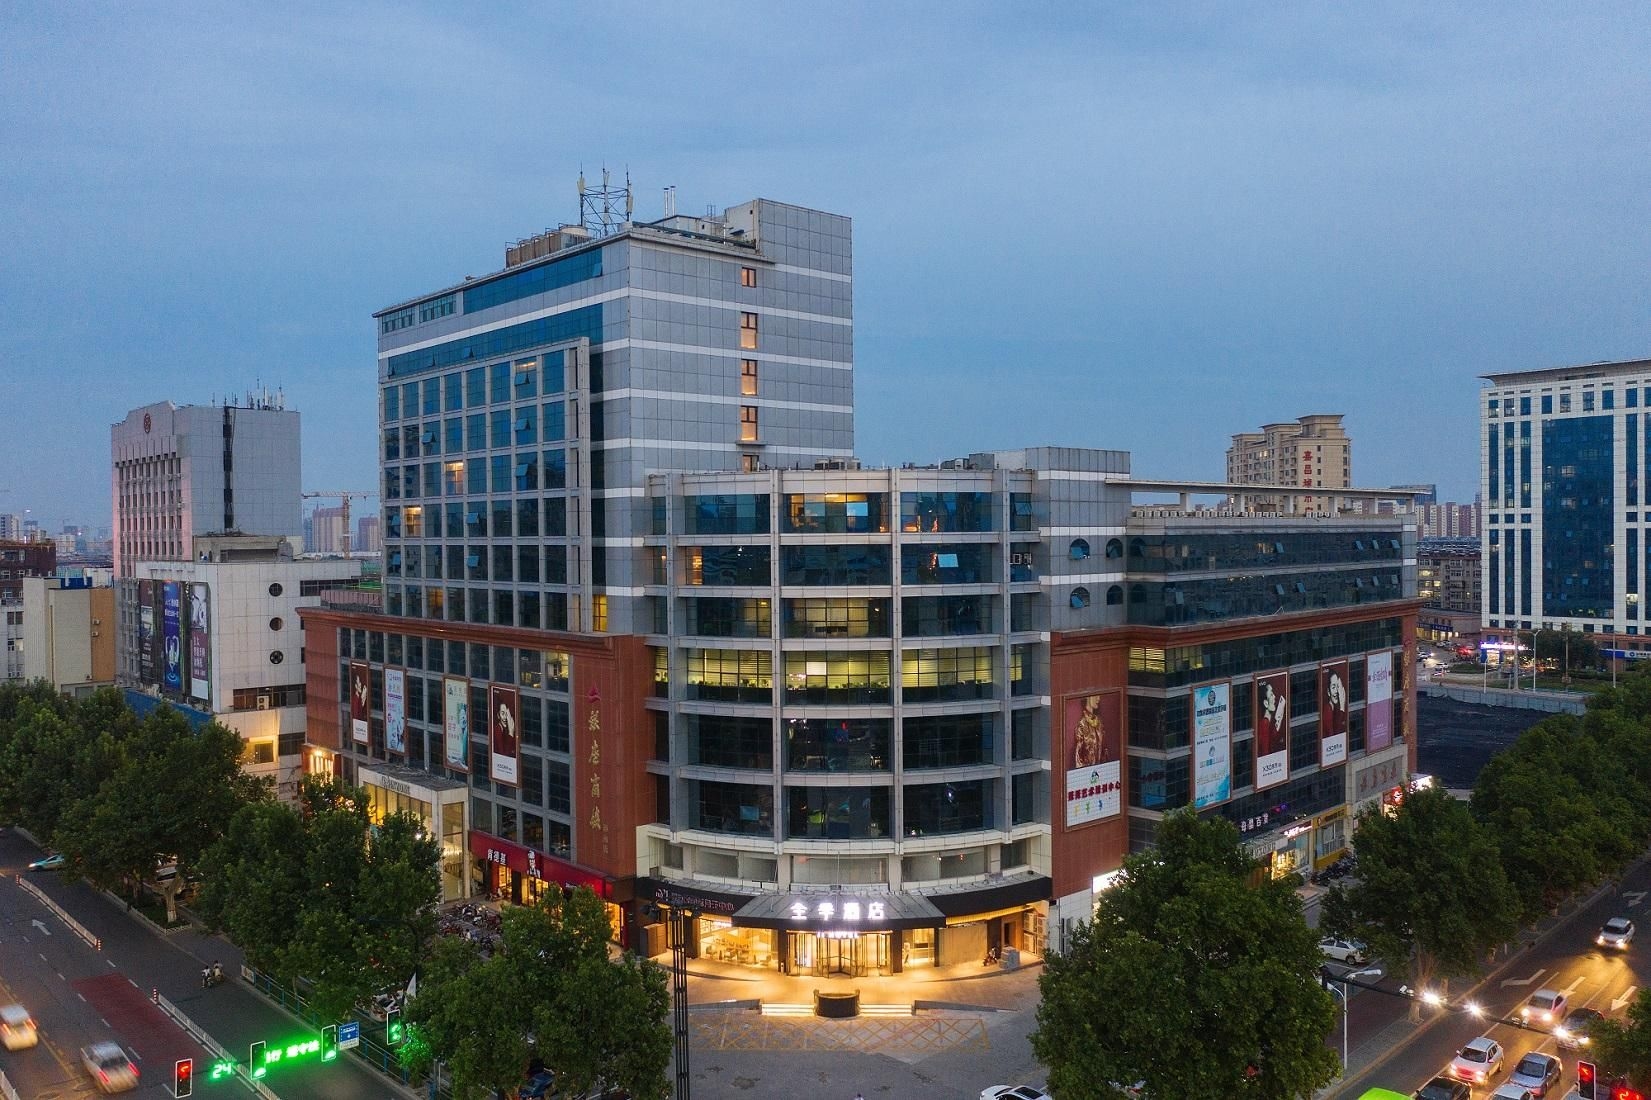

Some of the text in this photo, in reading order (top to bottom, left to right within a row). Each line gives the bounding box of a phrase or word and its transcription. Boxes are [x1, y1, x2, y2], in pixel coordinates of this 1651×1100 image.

[487, 848, 507, 866] 肯德基
[791, 902, 885, 920] 全季酒店
[212, 1062, 232, 1079] 24
